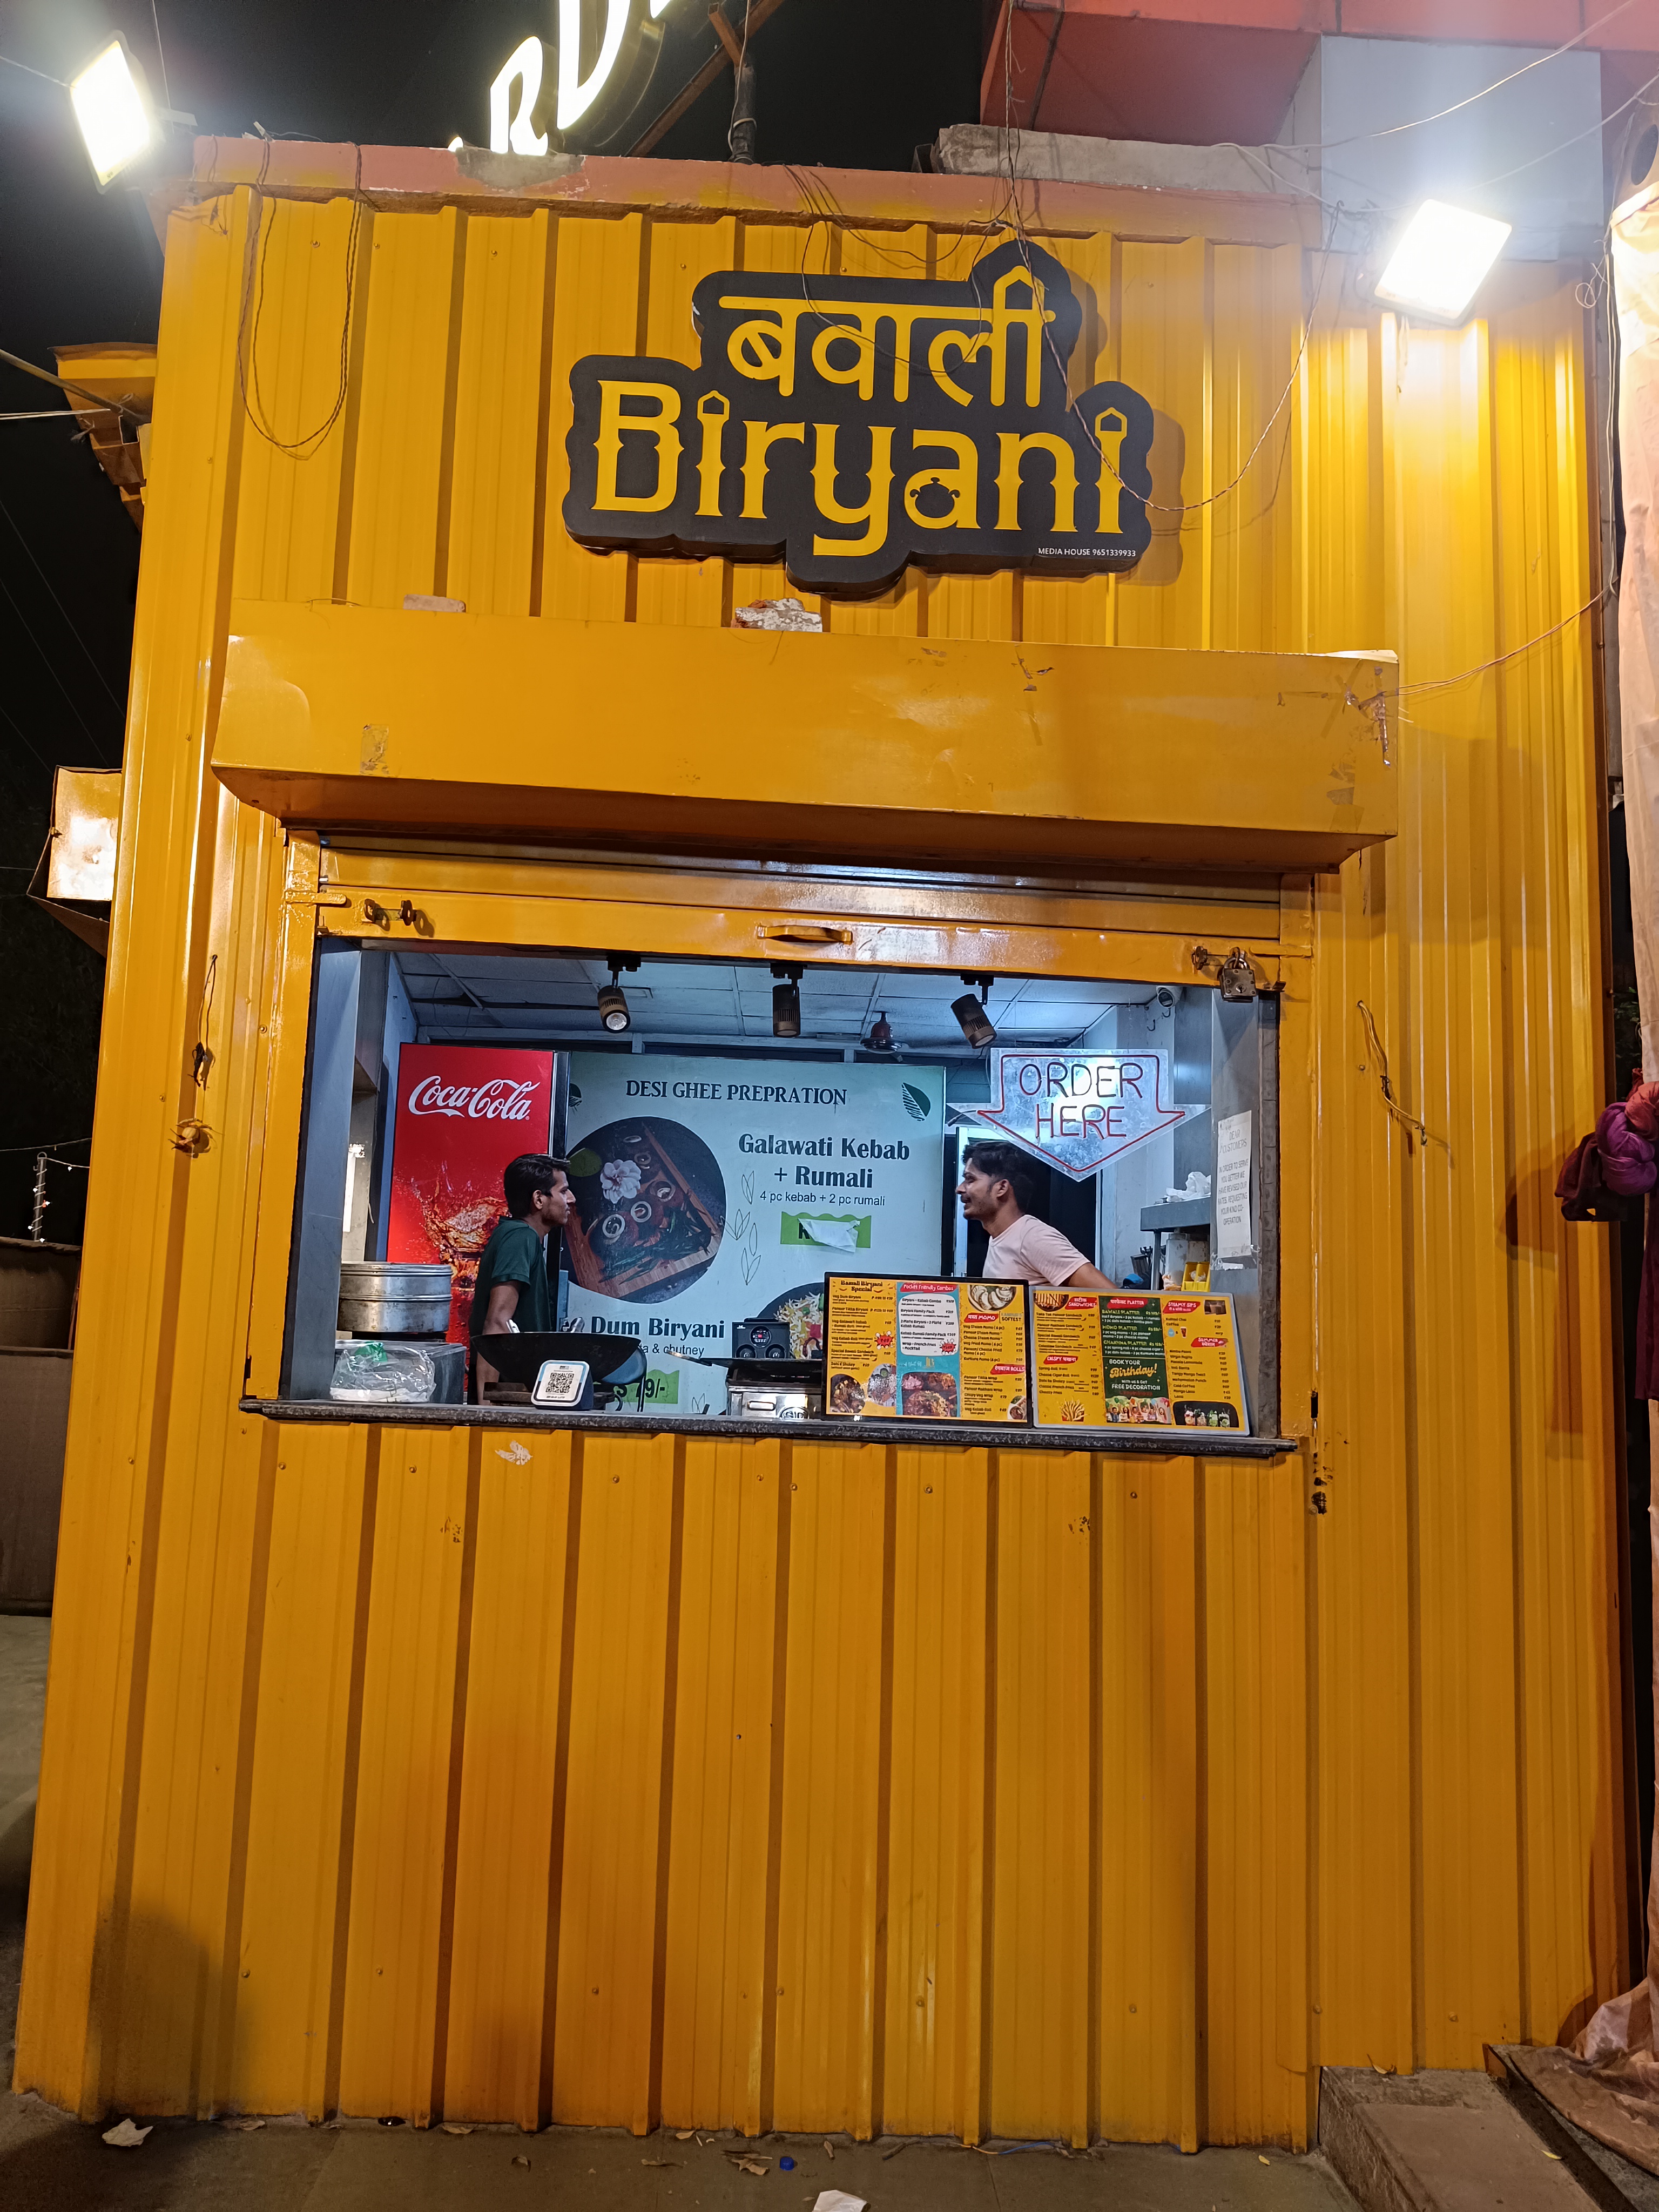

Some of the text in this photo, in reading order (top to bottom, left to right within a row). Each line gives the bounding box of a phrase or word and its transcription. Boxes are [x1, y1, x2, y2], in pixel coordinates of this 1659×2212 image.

[719, 265, 1056, 407] बवाली
[590, 380, 1128, 556] Biryani
[626, 1080, 847, 1105] DESI GHEE PREPRATION
[1020, 1062, 1143, 1098] ORDER
[409, 1076, 540, 1120] Coca-Cola
[1036, 1103, 1126, 1140] HERE
[739, 1133, 910, 1161] Galawati Kebab
[1230, 1129, 1240, 1141] DEAR
[774, 1166, 873, 1188] + Rumali
[760, 1191, 766, 1200] 4
[770, 1193, 782, 1203] pc
[785, 1192, 816, 1202] kebab
[829, 1194, 835, 1203] 2
[839, 1196, 851, 1206] pc
[854, 1196, 885, 1206] rumali
[591, 1316, 640, 1335] Dum
[648, 1318, 725, 1341] Biryani
[652, 1344, 660, 1353] &
[663, 1344, 704, 1359] chutney
[1110, 1363, 1157, 1378] Birthday!
